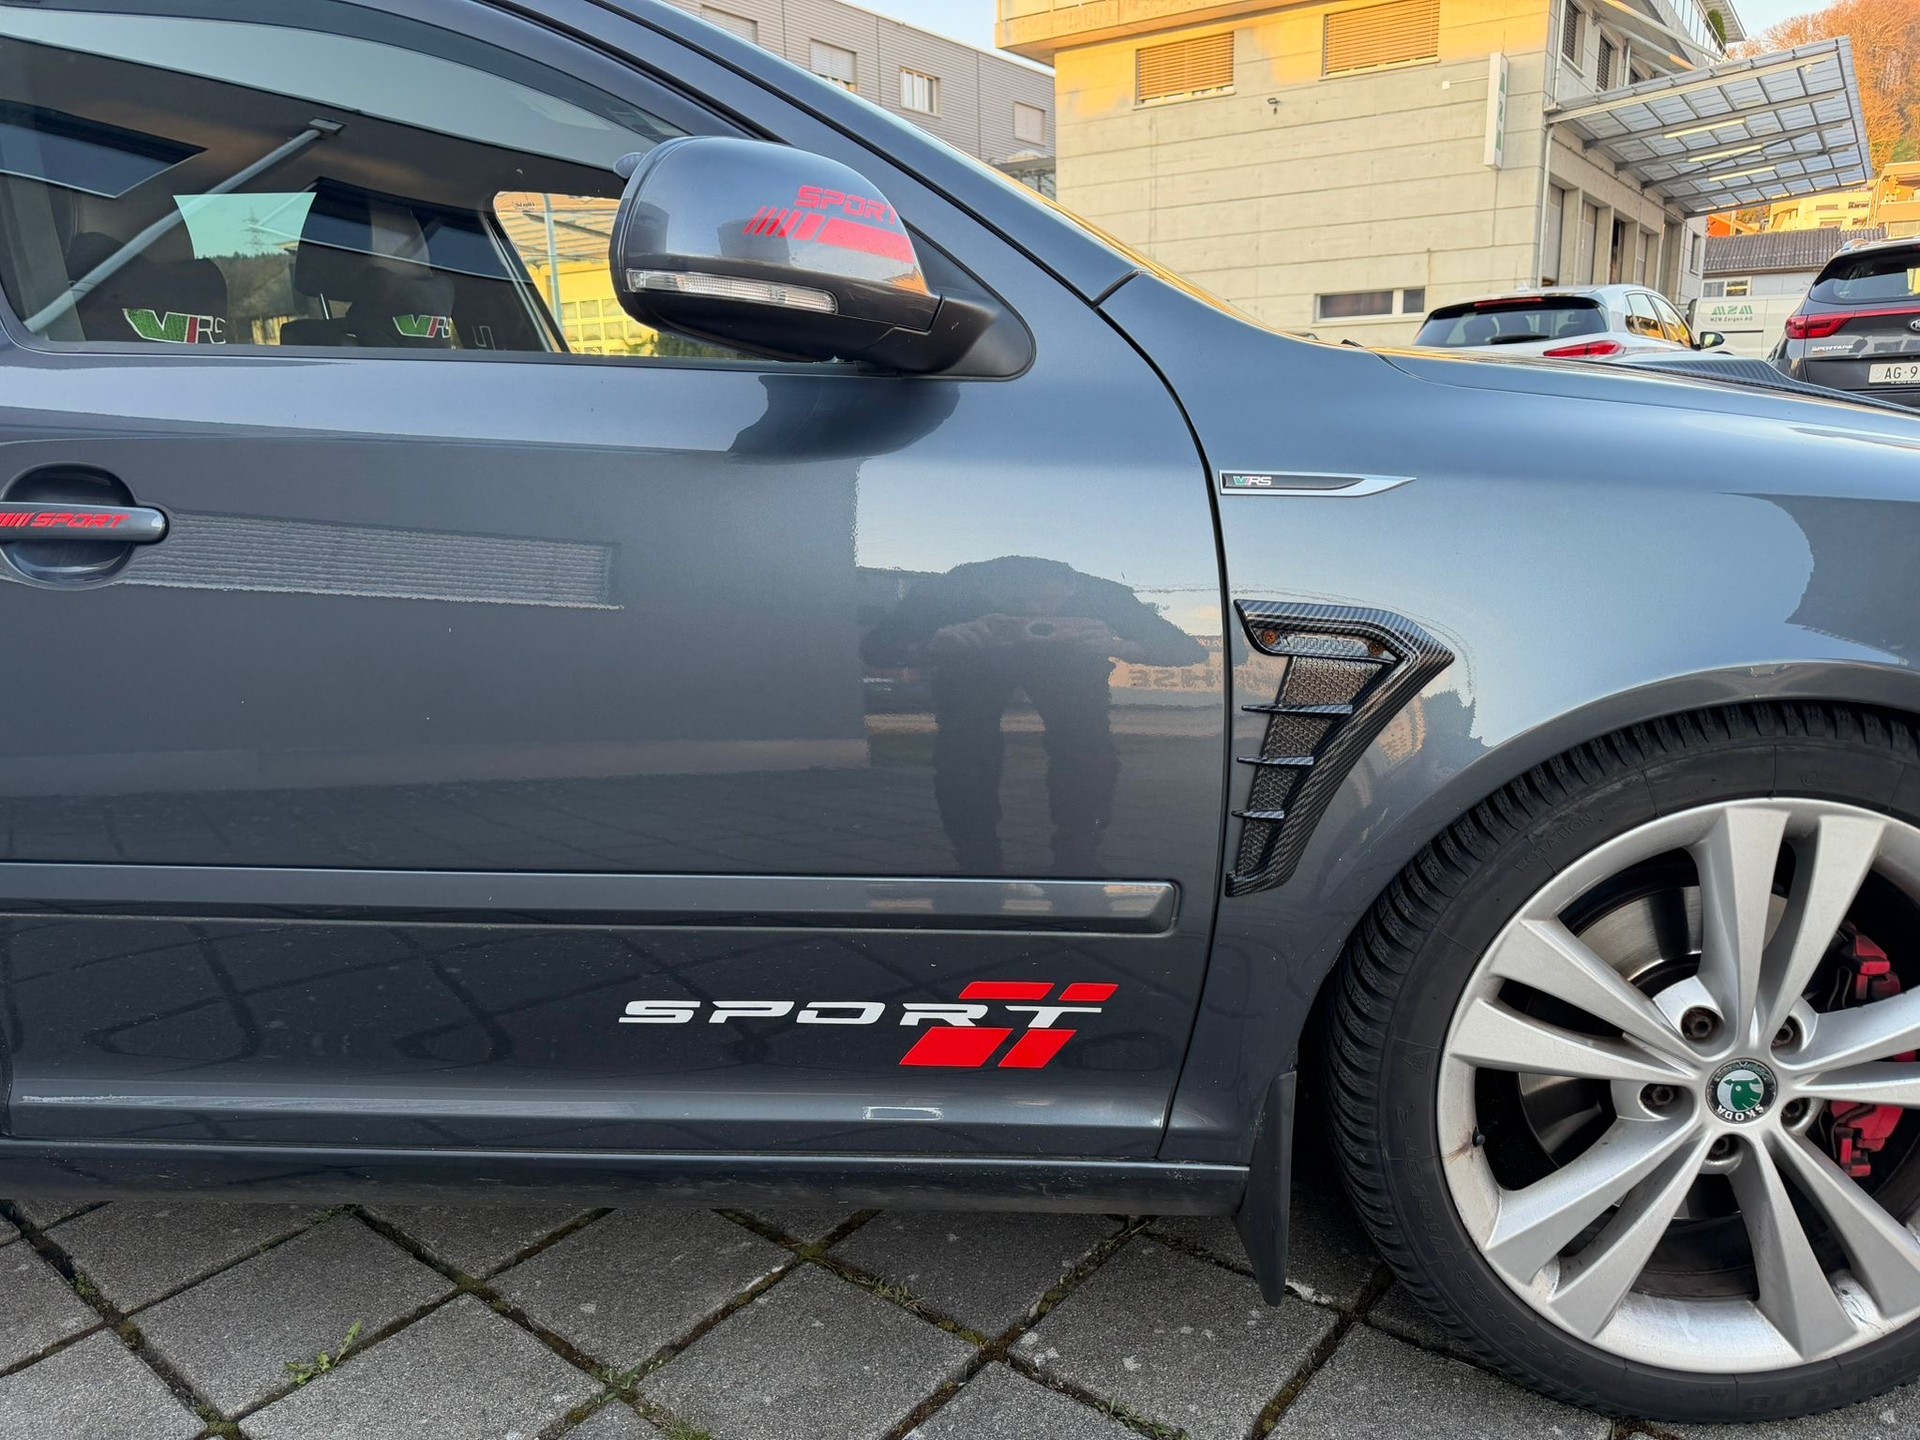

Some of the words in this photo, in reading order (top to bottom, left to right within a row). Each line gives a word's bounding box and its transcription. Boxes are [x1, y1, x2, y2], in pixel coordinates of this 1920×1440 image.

[794, 185, 897, 225] SPORT
[30, 512, 131, 529] SPORT
[618, 1000, 1102, 1029] SPORT
